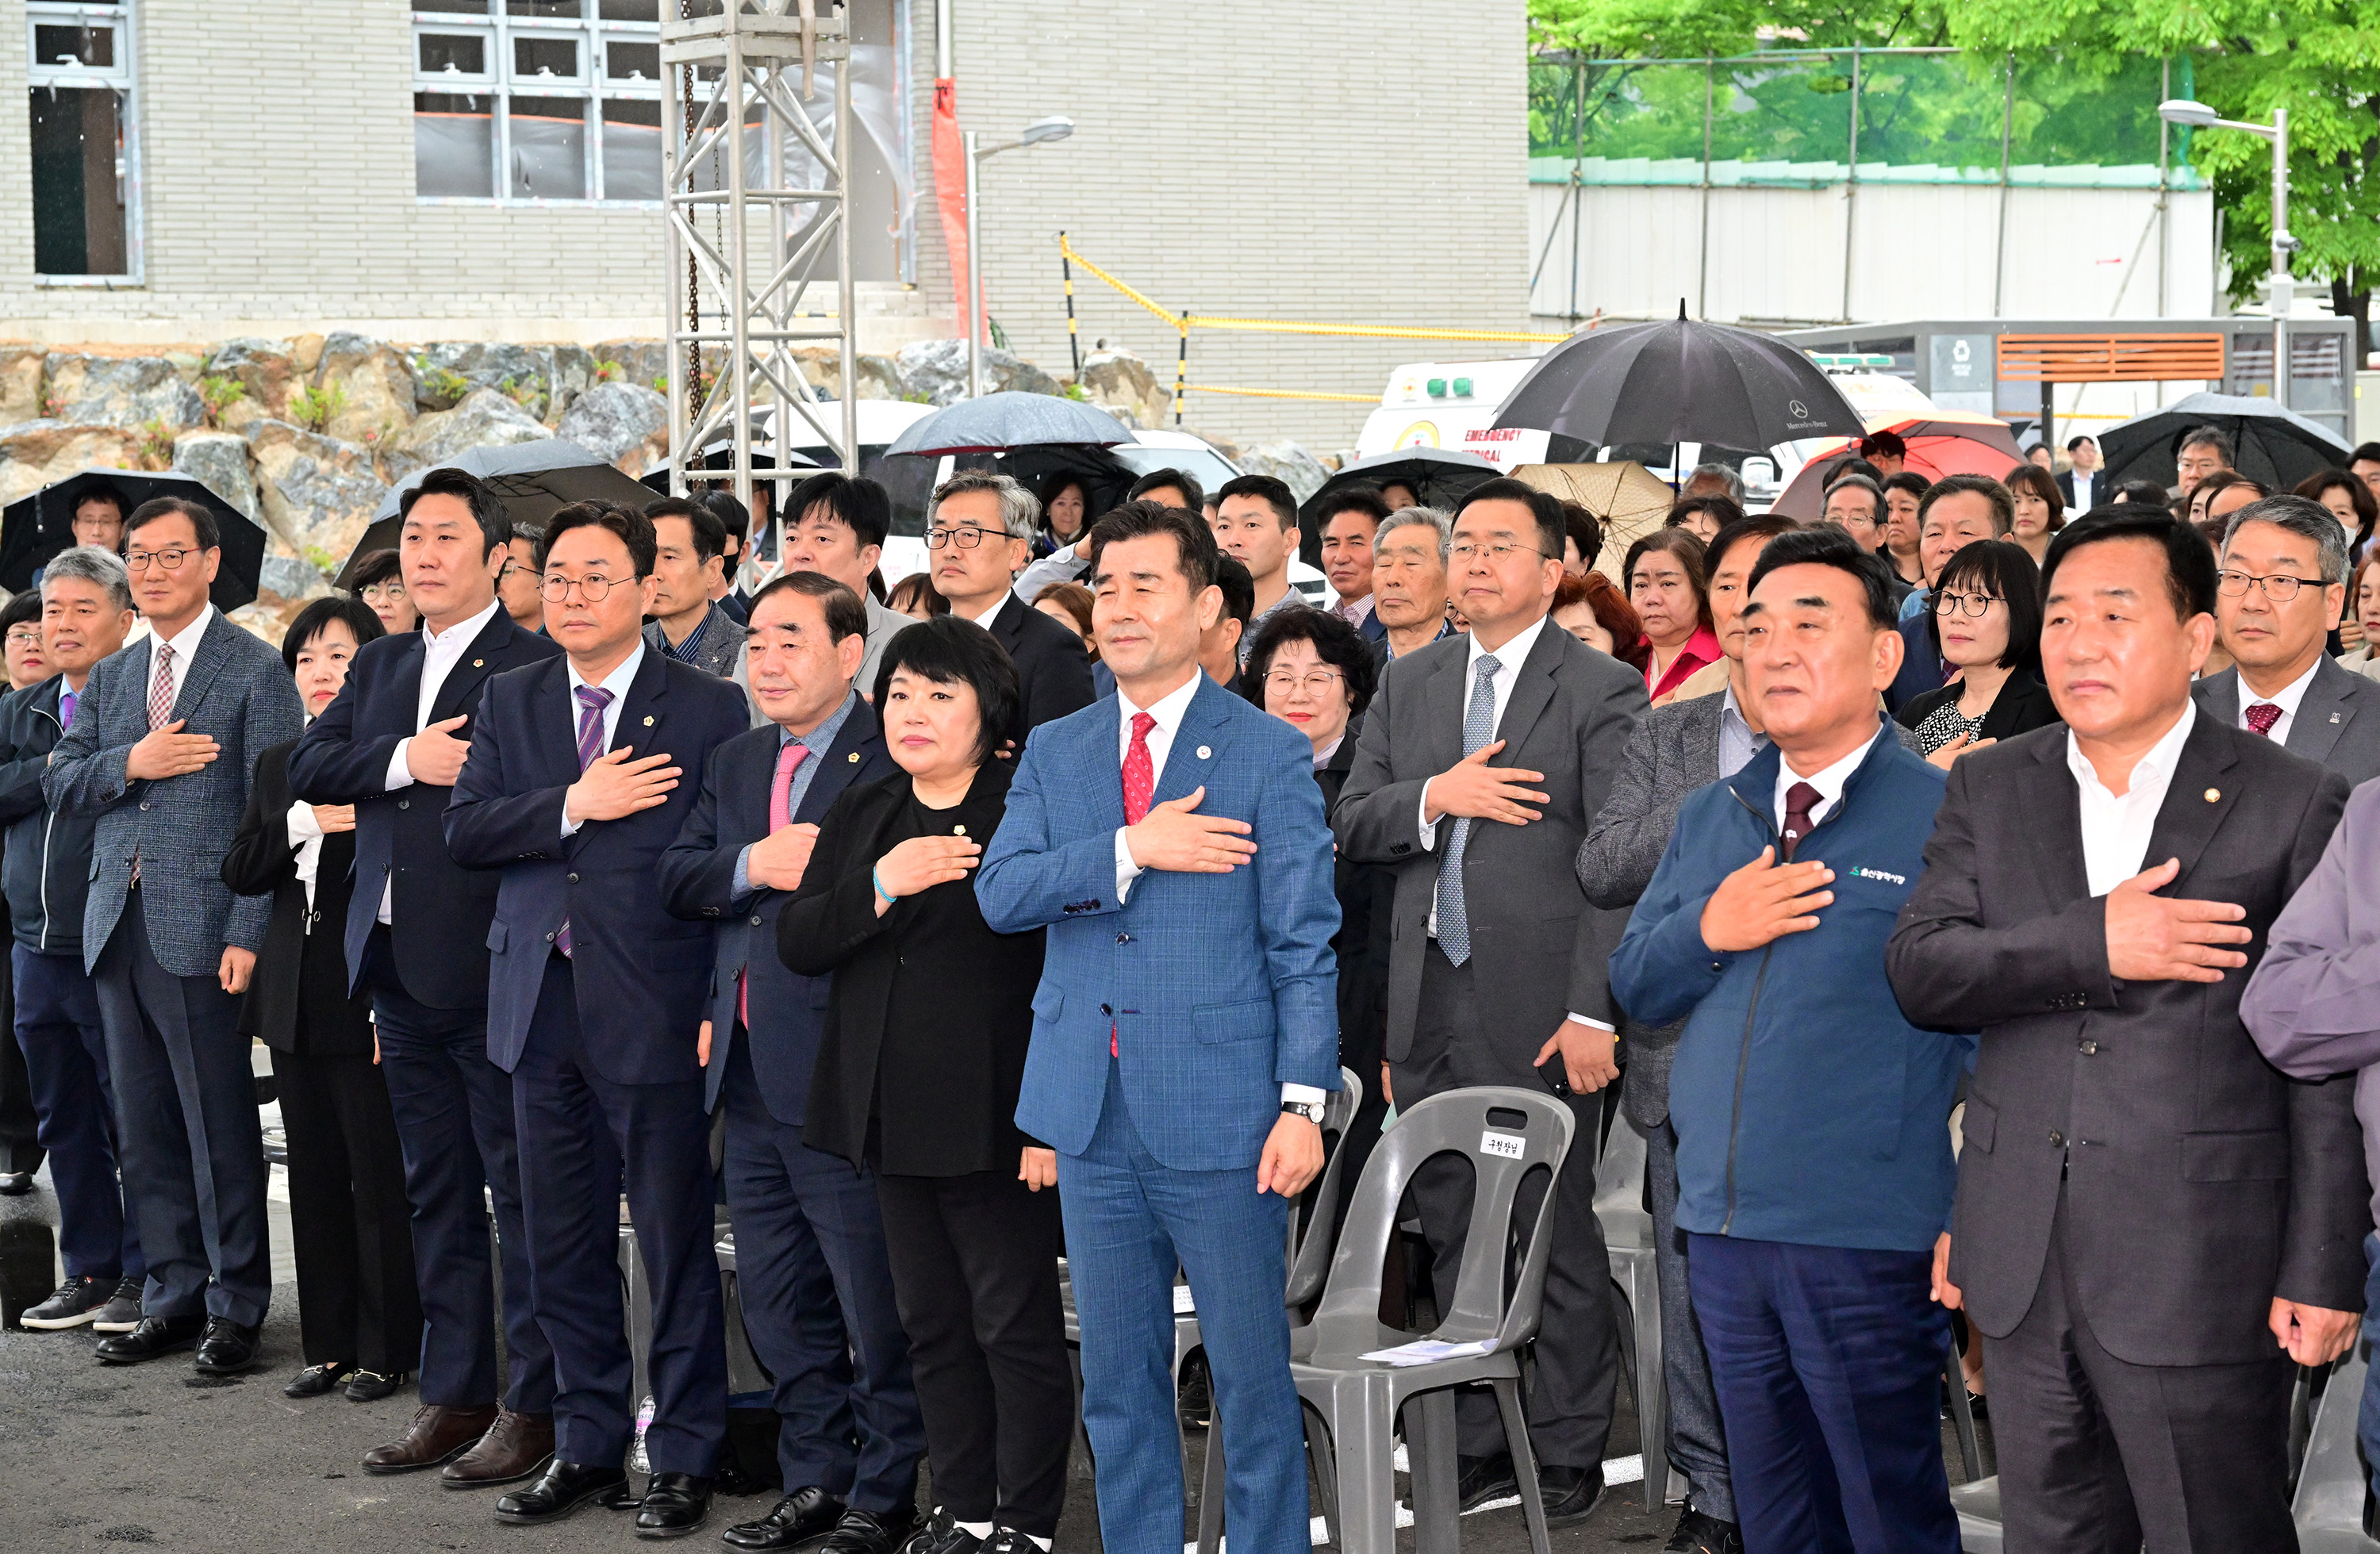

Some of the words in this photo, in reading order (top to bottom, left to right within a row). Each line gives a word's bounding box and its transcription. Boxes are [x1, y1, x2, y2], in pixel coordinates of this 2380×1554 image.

[1464, 428, 1523, 442] EMERGENCY
[1462, 450, 1501, 462] ICAL
[1488, 1139, 1518, 1154] 구청장님
